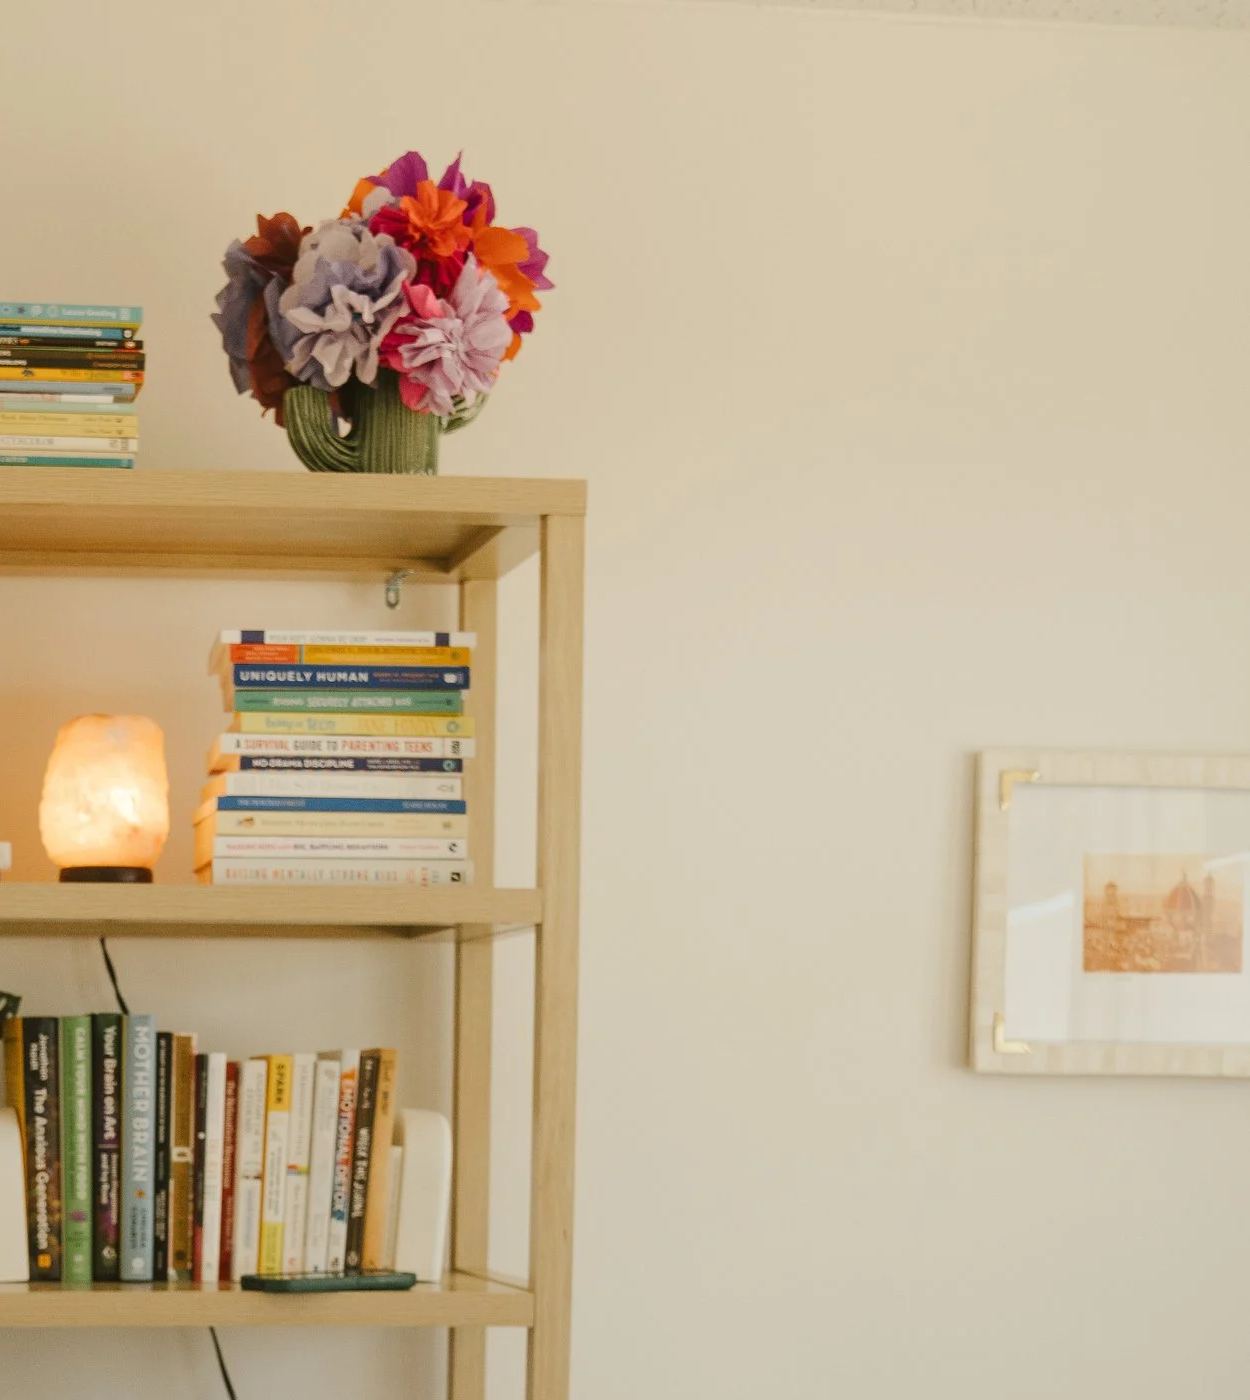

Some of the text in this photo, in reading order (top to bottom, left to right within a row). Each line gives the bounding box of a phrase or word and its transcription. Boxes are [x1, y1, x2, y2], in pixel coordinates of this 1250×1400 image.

[239, 670, 313, 682] UNIQUELY
[316, 671, 369, 682] HUMAN
[243, 740, 289, 750] SURVIVAL
[293, 740, 322, 751] GUIDE
[326, 741, 338, 751] TO
[341, 741, 399, 752] PARENTING
[404, 742, 433, 753] TEENS
[303, 759, 355, 769] DISCIPLINE
[37, 1033, 49, 1082] Jonathan
[74, 1026, 86, 1061] CALM
[103, 1025, 118, 1140] Your Brain on Art
[275, 1063, 286, 1104] SPARK
[132, 1026, 149, 1182] MOTHER BRAIN
[34, 1087, 50, 1250] The Anxious Generation
[75, 1166, 88, 1200] FOOD
